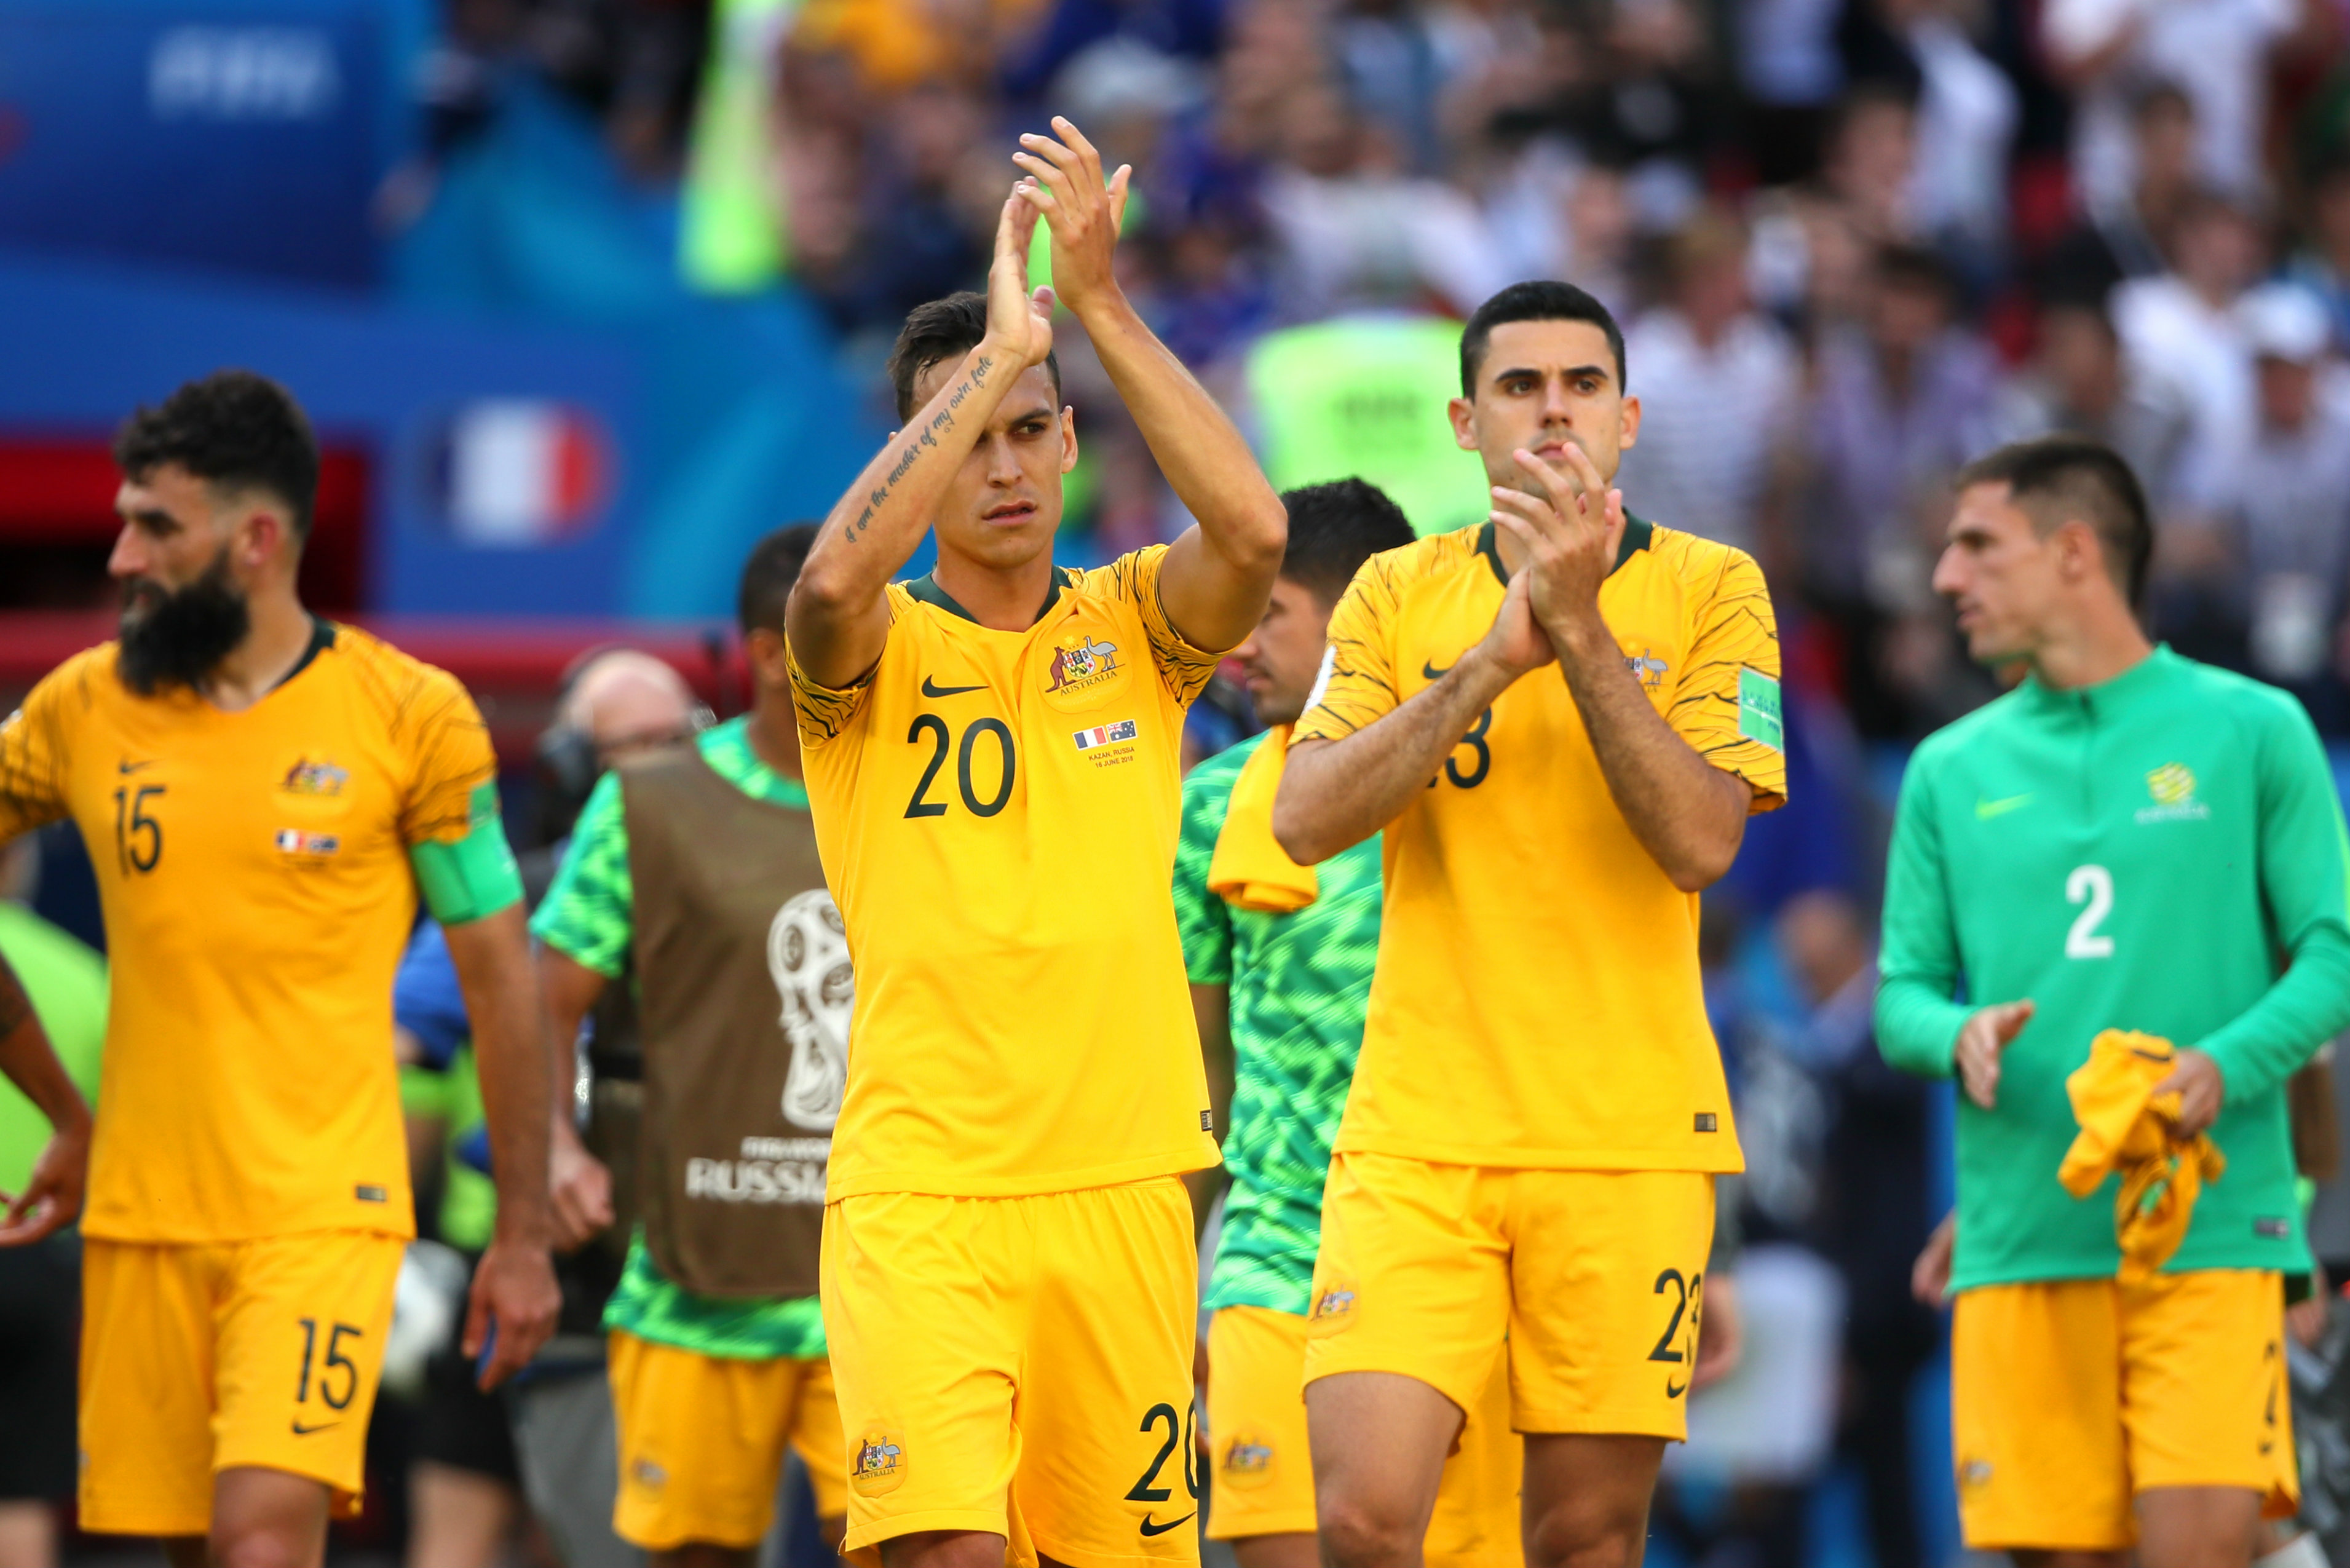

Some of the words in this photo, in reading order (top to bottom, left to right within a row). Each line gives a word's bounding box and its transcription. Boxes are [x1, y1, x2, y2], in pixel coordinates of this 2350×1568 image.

[857, 505, 874, 531] am
[871, 486, 888, 507] the
[887, 443, 921, 486] master
[920, 426, 937, 446] of
[933, 408, 955, 433] my
[949, 382, 972, 408] own
[971, 356, 993, 389] fate
[1060, 670, 1117, 696] AUSTRALIA
[903, 713, 1016, 818] 20
[1088, 751, 1112, 761] KAZAN,
[1113, 746, 1135, 756] RUSSIA
[1103, 758, 1120, 767] JUNE
[1426, 706, 1492, 788] 3
[115, 785, 166, 879] 15
[2065, 864, 2115, 959] 2
[685, 1157, 827, 1203] RUSSI
[297, 1318, 363, 1410] 15
[859, 1468, 895, 1480] AUSTRALIA
